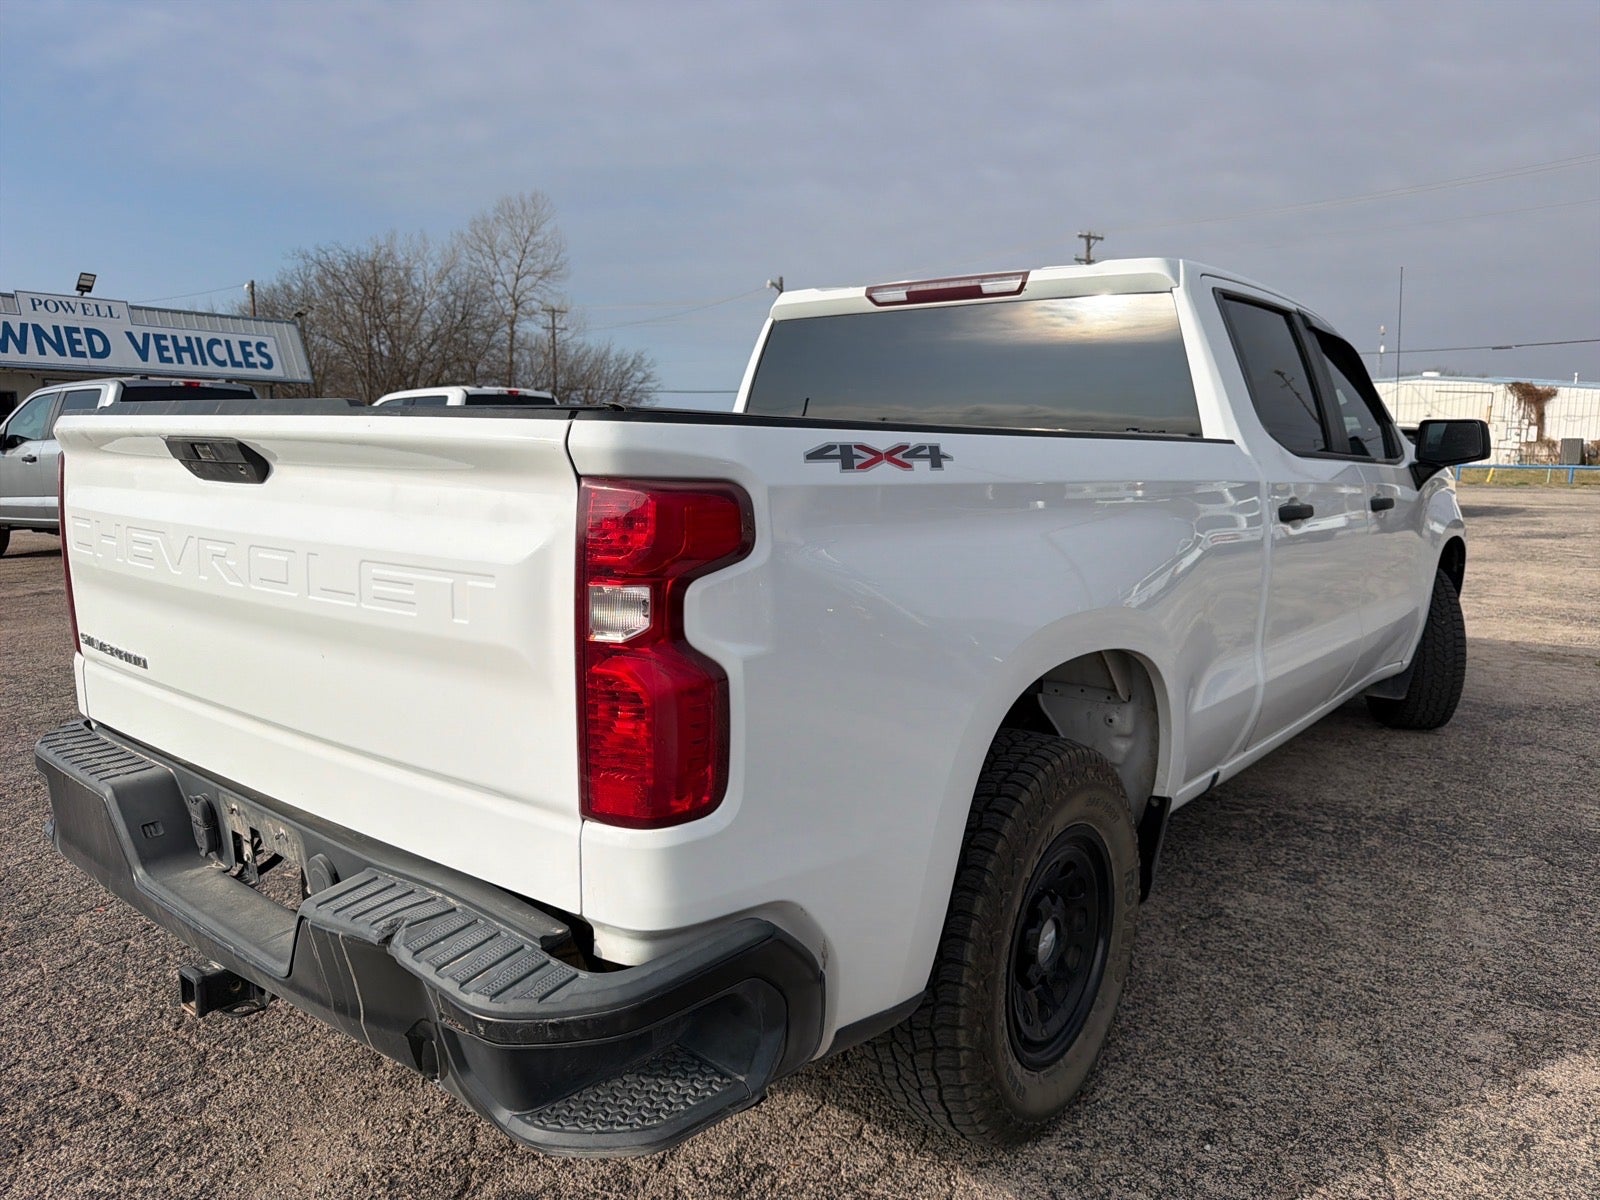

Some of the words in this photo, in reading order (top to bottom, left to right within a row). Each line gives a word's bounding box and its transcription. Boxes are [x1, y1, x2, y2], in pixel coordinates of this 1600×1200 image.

[30, 297, 120, 319] POWELL
[125, 330, 274, 370] VEHICLES
[71, 514, 497, 625] CHEVROLET
